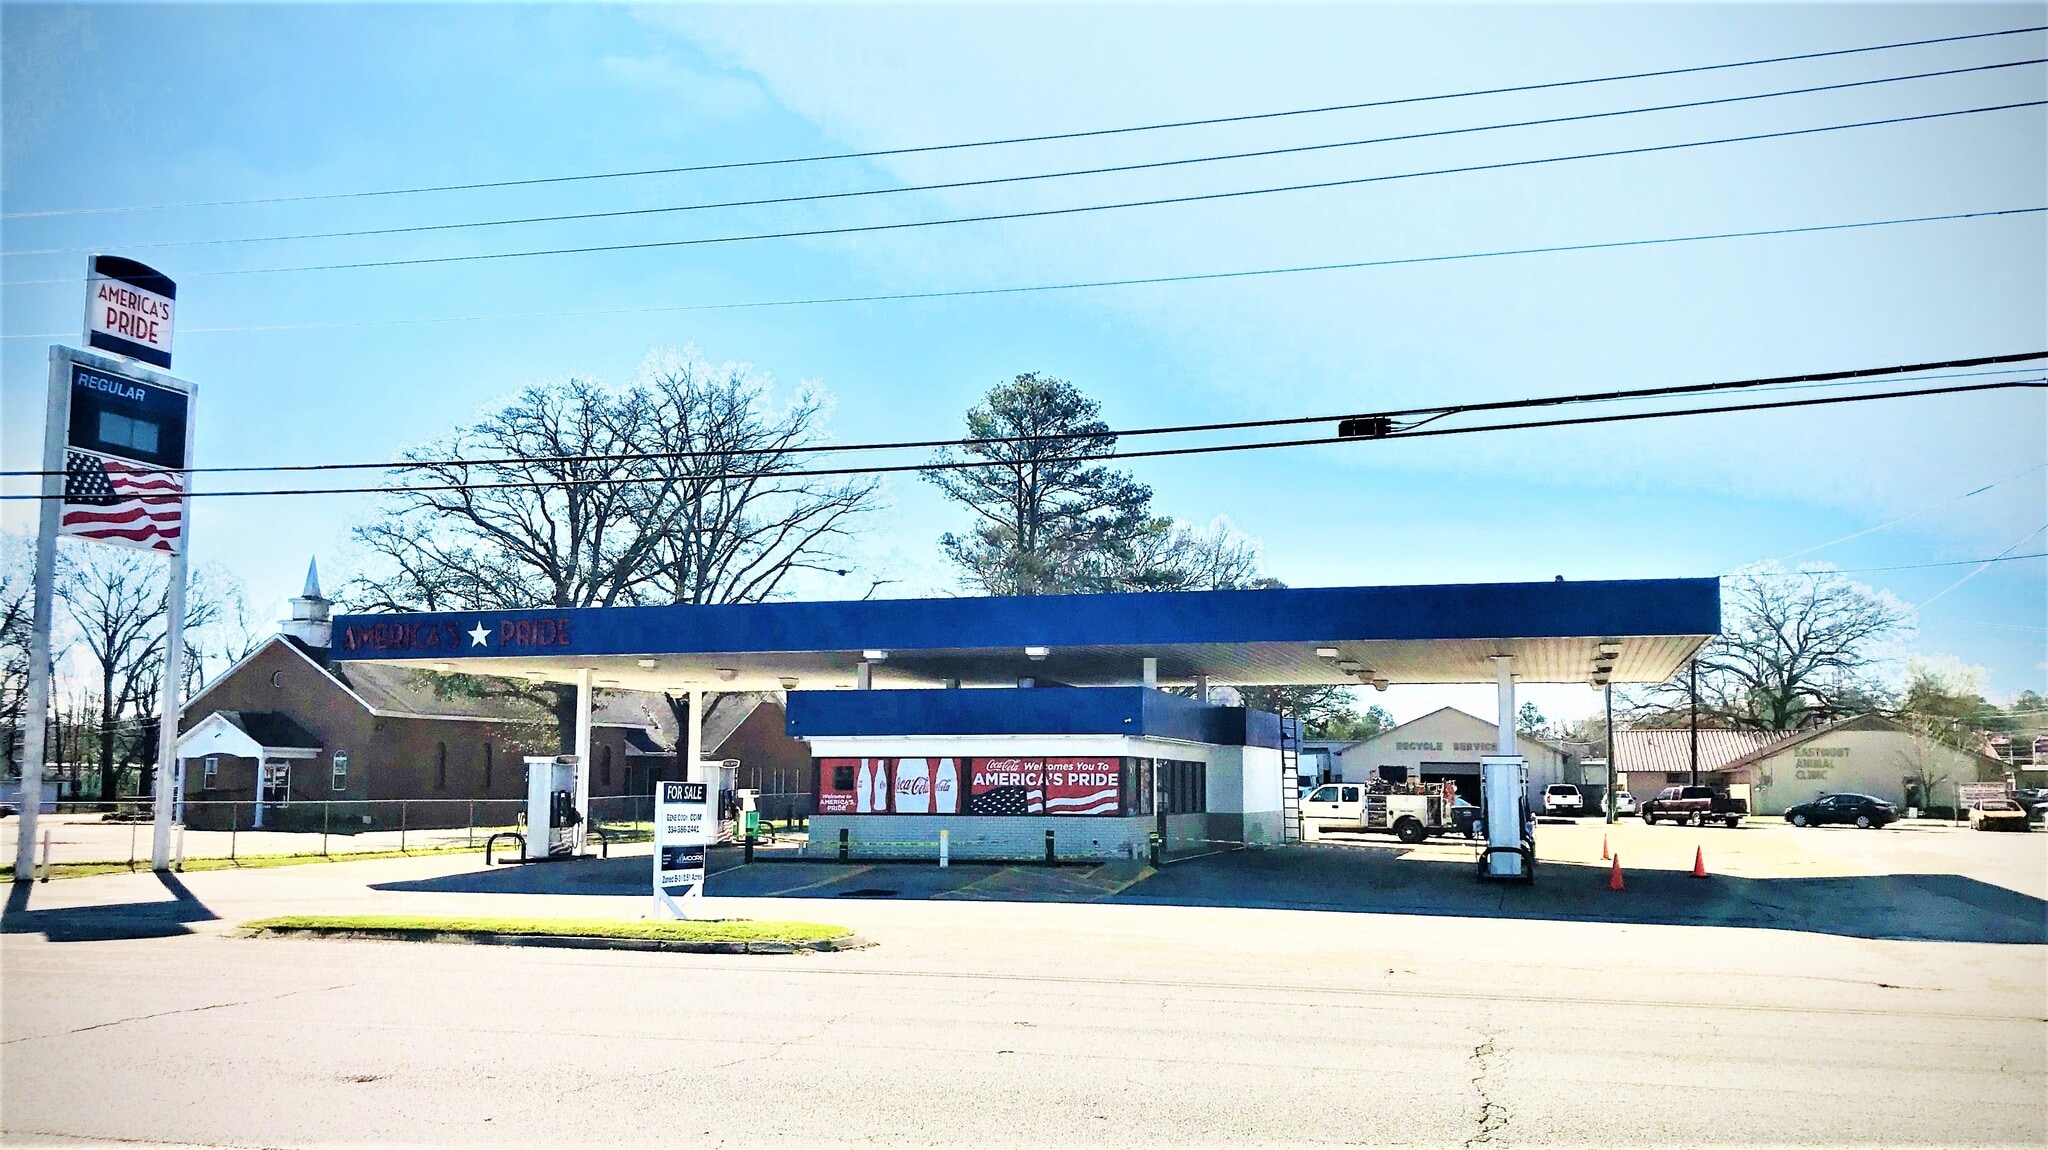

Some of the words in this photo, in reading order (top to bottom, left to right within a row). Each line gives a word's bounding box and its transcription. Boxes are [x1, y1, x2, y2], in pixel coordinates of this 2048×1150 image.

[98, 284, 169, 320] AMERICA'S
[106, 306, 159, 344] PRIDE
[78, 372, 145, 402] REGULAR
[344, 620, 461, 650] AMERICA'S
[501, 617, 571, 647] PRIDE
[973, 772, 1063, 786] AMERICA'S
[1068, 772, 1118, 786] PRIDE
[1076, 761, 1095, 771] You
[1097, 761, 1110, 771] To
[667, 785, 683, 800] FOR
[684, 785, 702, 800] SALE
